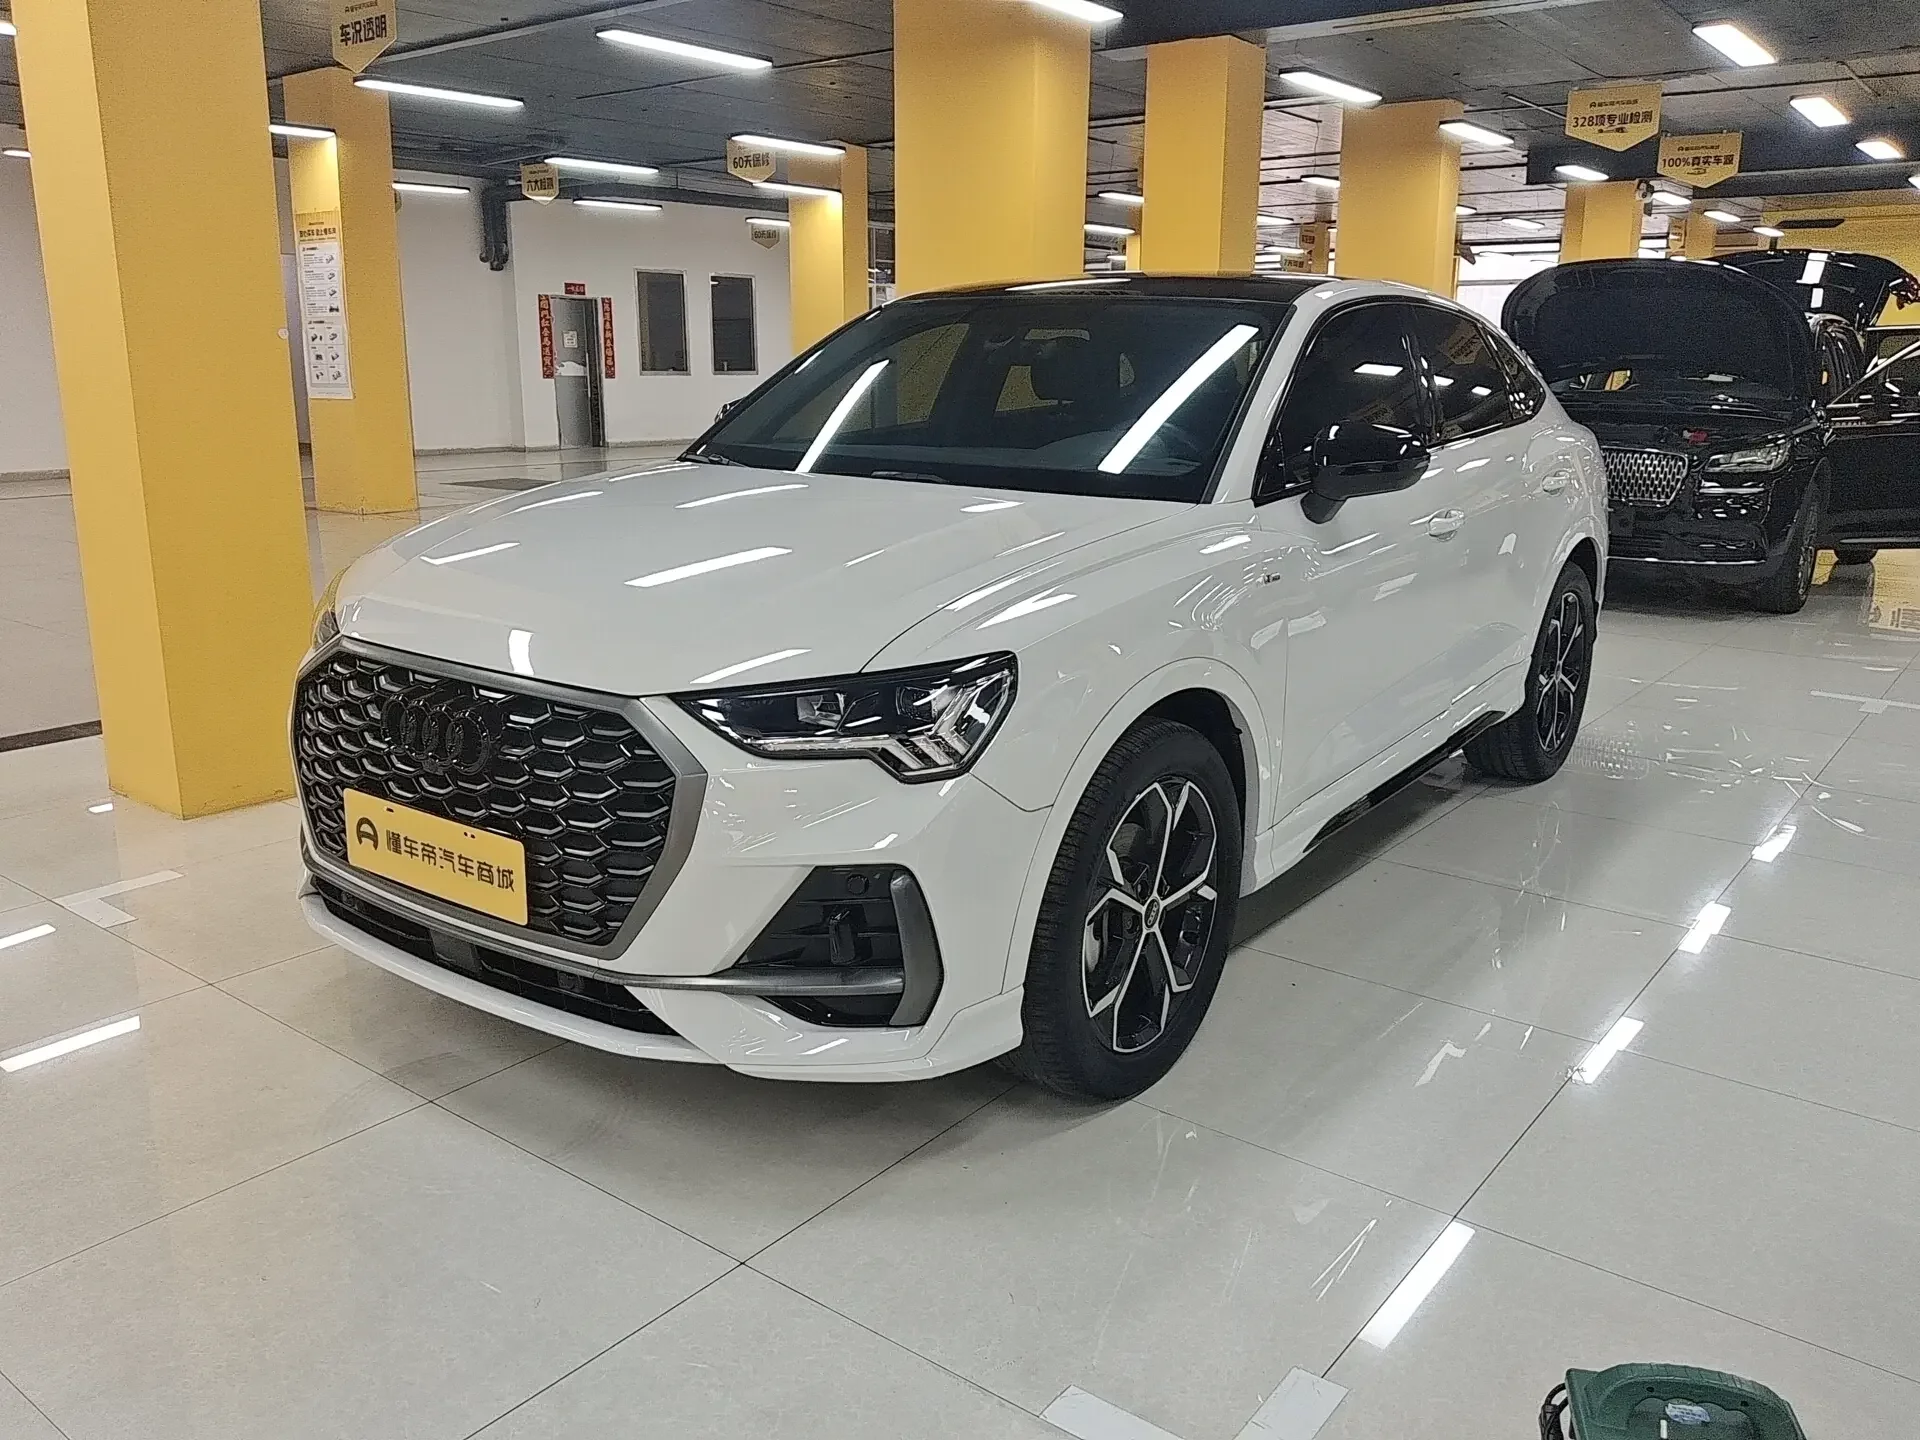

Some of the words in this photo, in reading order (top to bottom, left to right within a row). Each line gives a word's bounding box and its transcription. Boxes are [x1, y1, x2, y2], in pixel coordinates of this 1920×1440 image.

[339, 14, 387, 46] 车况透明
[1572, 109, 1653, 128] 328项专业检测
[733, 151, 770, 169] 60天保修
[385, 829, 516, 892] 懂车帝汽车商城
